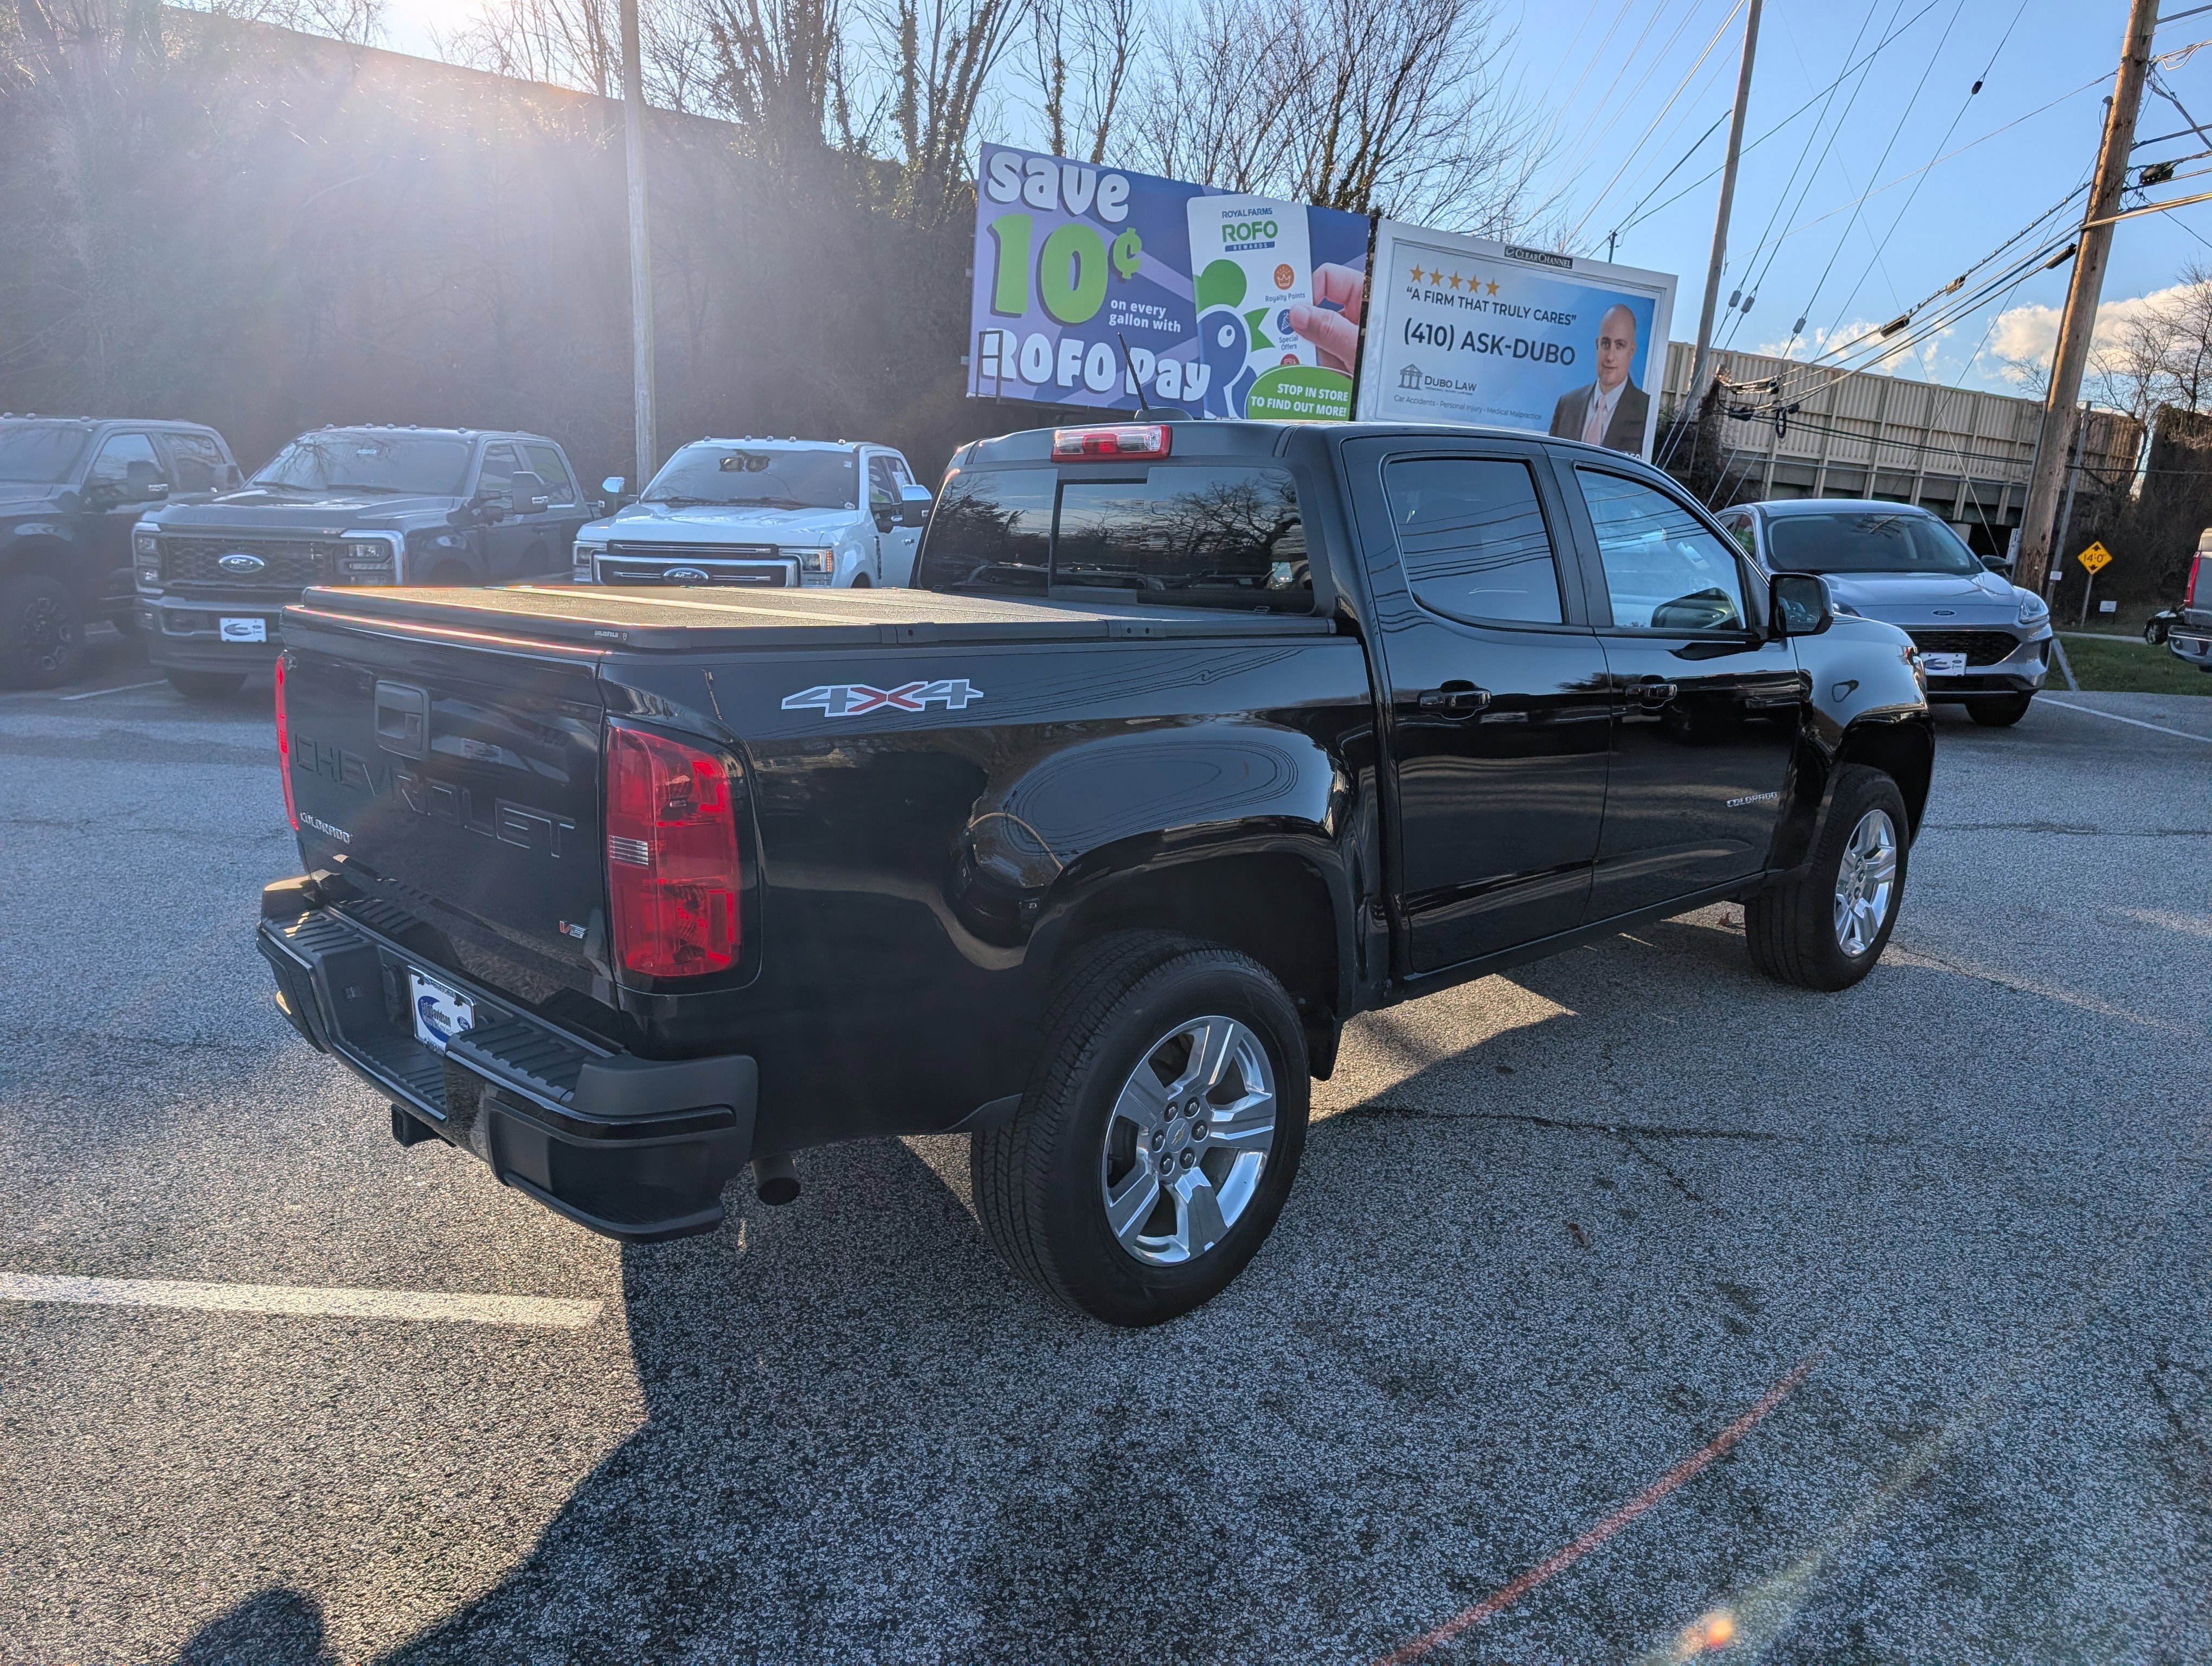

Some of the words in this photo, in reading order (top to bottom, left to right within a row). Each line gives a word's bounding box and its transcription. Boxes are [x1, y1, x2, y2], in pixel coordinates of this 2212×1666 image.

[1222, 209, 1247, 218] ROYAL
[1248, 208, 1273, 216] FARMS
[1221, 220, 1278, 243] ROFO
[1233, 242, 1268, 251] REWARDS
[1110, 299, 1127, 310] on
[1130, 303, 1166, 319] every
[1265, 295, 1287, 303] Royalty
[1424, 290, 1454, 306] FIRM
[1458, 296, 1489, 312] THAT
[1492, 302, 1531, 319] TRULY
[1109, 313, 1149, 328] gallon
[1153, 319, 1181, 332] with
[1279, 335, 1299, 344] Special
[1404, 317, 1455, 351] (410)
[1460, 330, 1576, 366] ASK-DUBO
[982, 328, 1117, 392] ROFO
[1126, 347, 1211, 401] Pay
[1277, 383, 1303, 395] STOP
[1305, 387, 1317, 398] IN
[1318, 388, 1348, 401] STORE
[1251, 396, 1265, 407] TO
[1266, 398, 1291, 410] FIND
[1293, 401, 1315, 413] OUT
[1316, 405, 1347, 417] MORE!
[1394, 394, 1405, 402] Car
[1406, 396, 1436, 407] Accidents
[1439, 400, 1465, 410] Personal
[1465, 404, 1483, 414] Injury
[1486, 407, 1508, 415] Medical
[1509, 410, 1542, 420] Malpractice
[294, 732, 576, 858] CHEVROLET
[1726, 791, 1777, 808] COLORADO
[300, 812, 350, 844] COLORADO
[559, 920, 586, 939] V6
